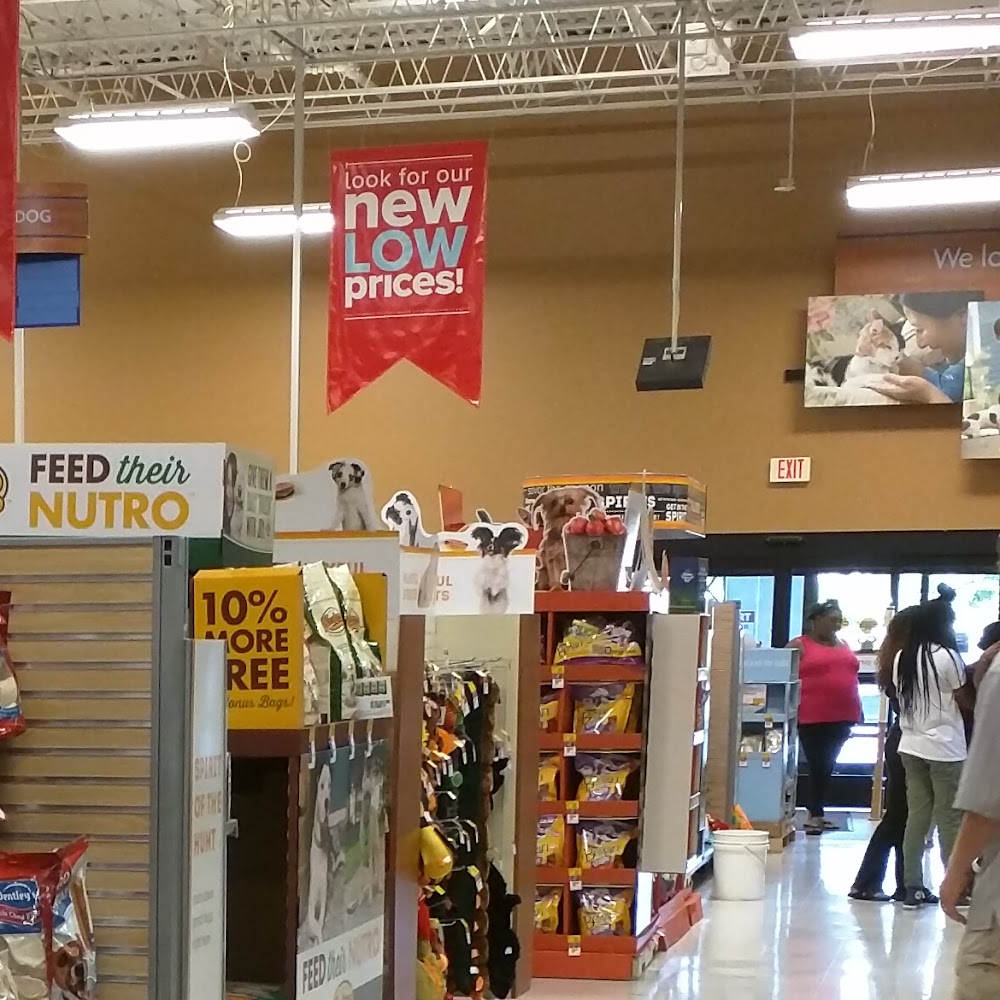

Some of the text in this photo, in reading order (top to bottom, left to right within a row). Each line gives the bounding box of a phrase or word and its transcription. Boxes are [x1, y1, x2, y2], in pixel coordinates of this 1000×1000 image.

[345, 166, 473, 190] look for our
[15, 209, 52, 224] DOG
[344, 185, 473, 230] new
[344, 225, 468, 274] LOW
[933, 247, 973, 269] We
[344, 267, 463, 308] prices!
[30, 454, 190, 485] FEED their
[777, 459, 805, 480] EXIT
[29, 491, 190, 531] NUTRO
[202, 589, 288, 626] 10%
[227, 657, 289, 691] REE
[257, 695, 295, 712] Bags!
[194, 755, 222, 782] SPIRIT
[194, 791, 222, 818] OF THE
[193, 828, 216, 857] HUNT
[302, 953, 326, 994] FEED
